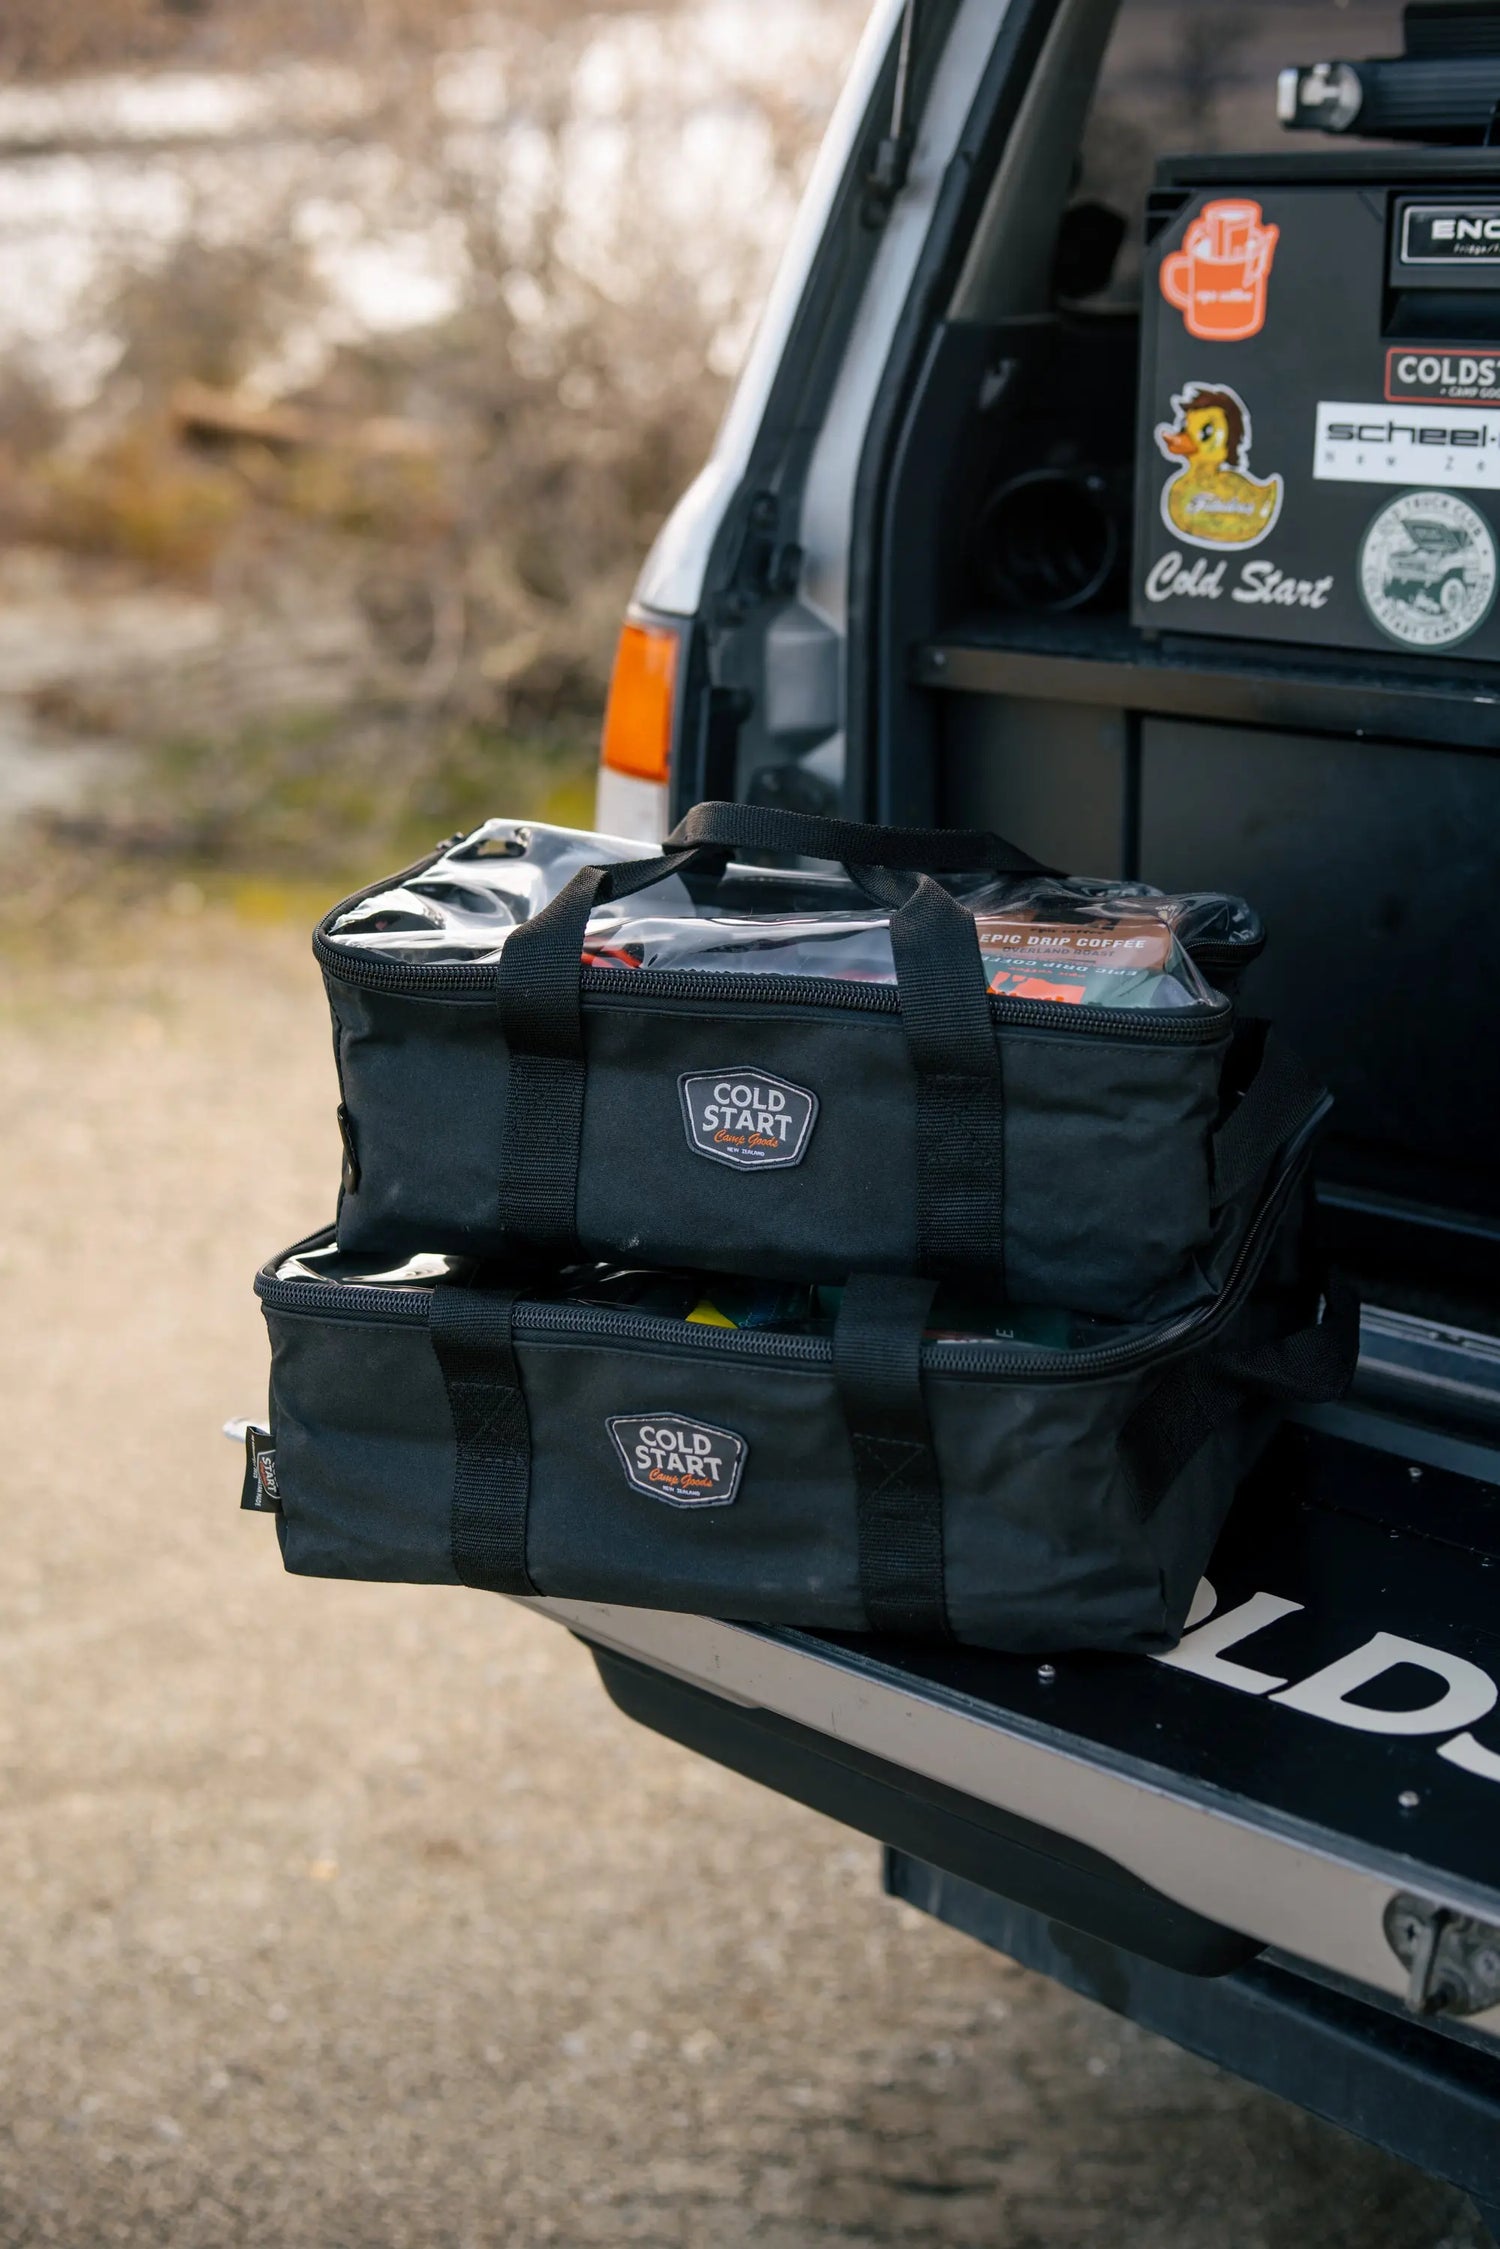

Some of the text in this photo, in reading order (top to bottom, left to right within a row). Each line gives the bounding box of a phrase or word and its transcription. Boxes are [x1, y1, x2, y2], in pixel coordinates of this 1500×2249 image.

[1397, 355, 1500, 387] COLDS
[1145, 550, 1334, 609] Cold Start
[980, 933, 1147, 949] EPIC DRIP COFFEE
[1002, 946, 1115, 958] OVERLAND ROAST
[713, 1082, 786, 1112] COLD
[702, 1104, 792, 1142] START
[714, 1129, 779, 1148] Camp Goods
[741, 1148, 765, 1157] ZEALAND
[639, 1425, 712, 1456] COLD
[262, 1456, 277, 1493] START
[635, 1445, 722, 1481] START
[649, 1467, 713, 1488] Camp Goods
[1147, 1576, 1500, 1783] LD
